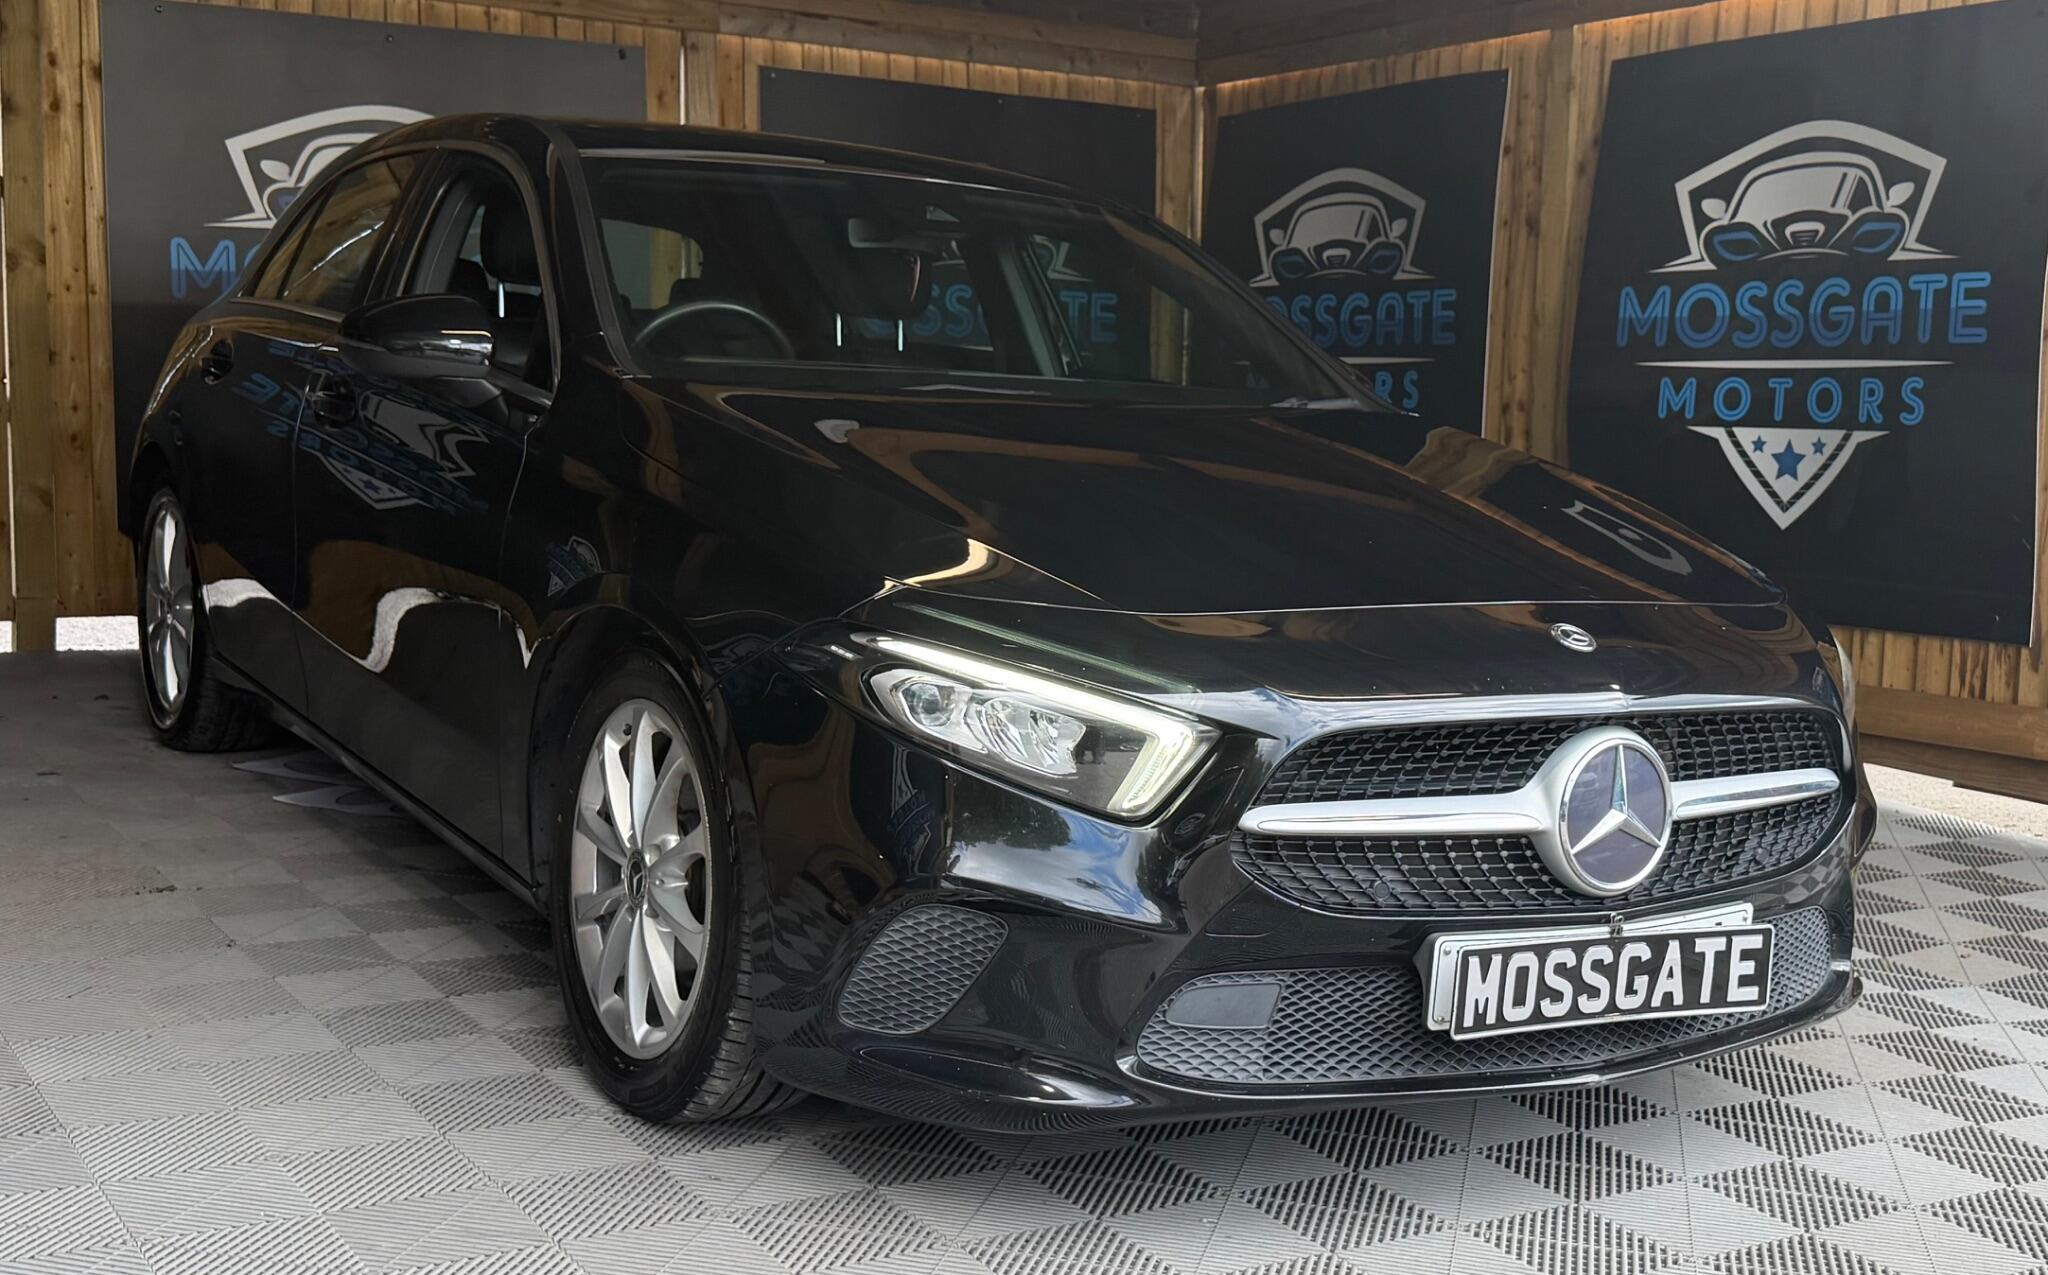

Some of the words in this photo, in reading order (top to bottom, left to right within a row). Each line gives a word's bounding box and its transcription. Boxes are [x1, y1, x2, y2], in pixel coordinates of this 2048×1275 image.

[1616, 271, 1992, 349] MOSSGATE
[1657, 376, 1925, 426] MOTORS
[1463, 934, 1763, 1028] MOSSGATE
